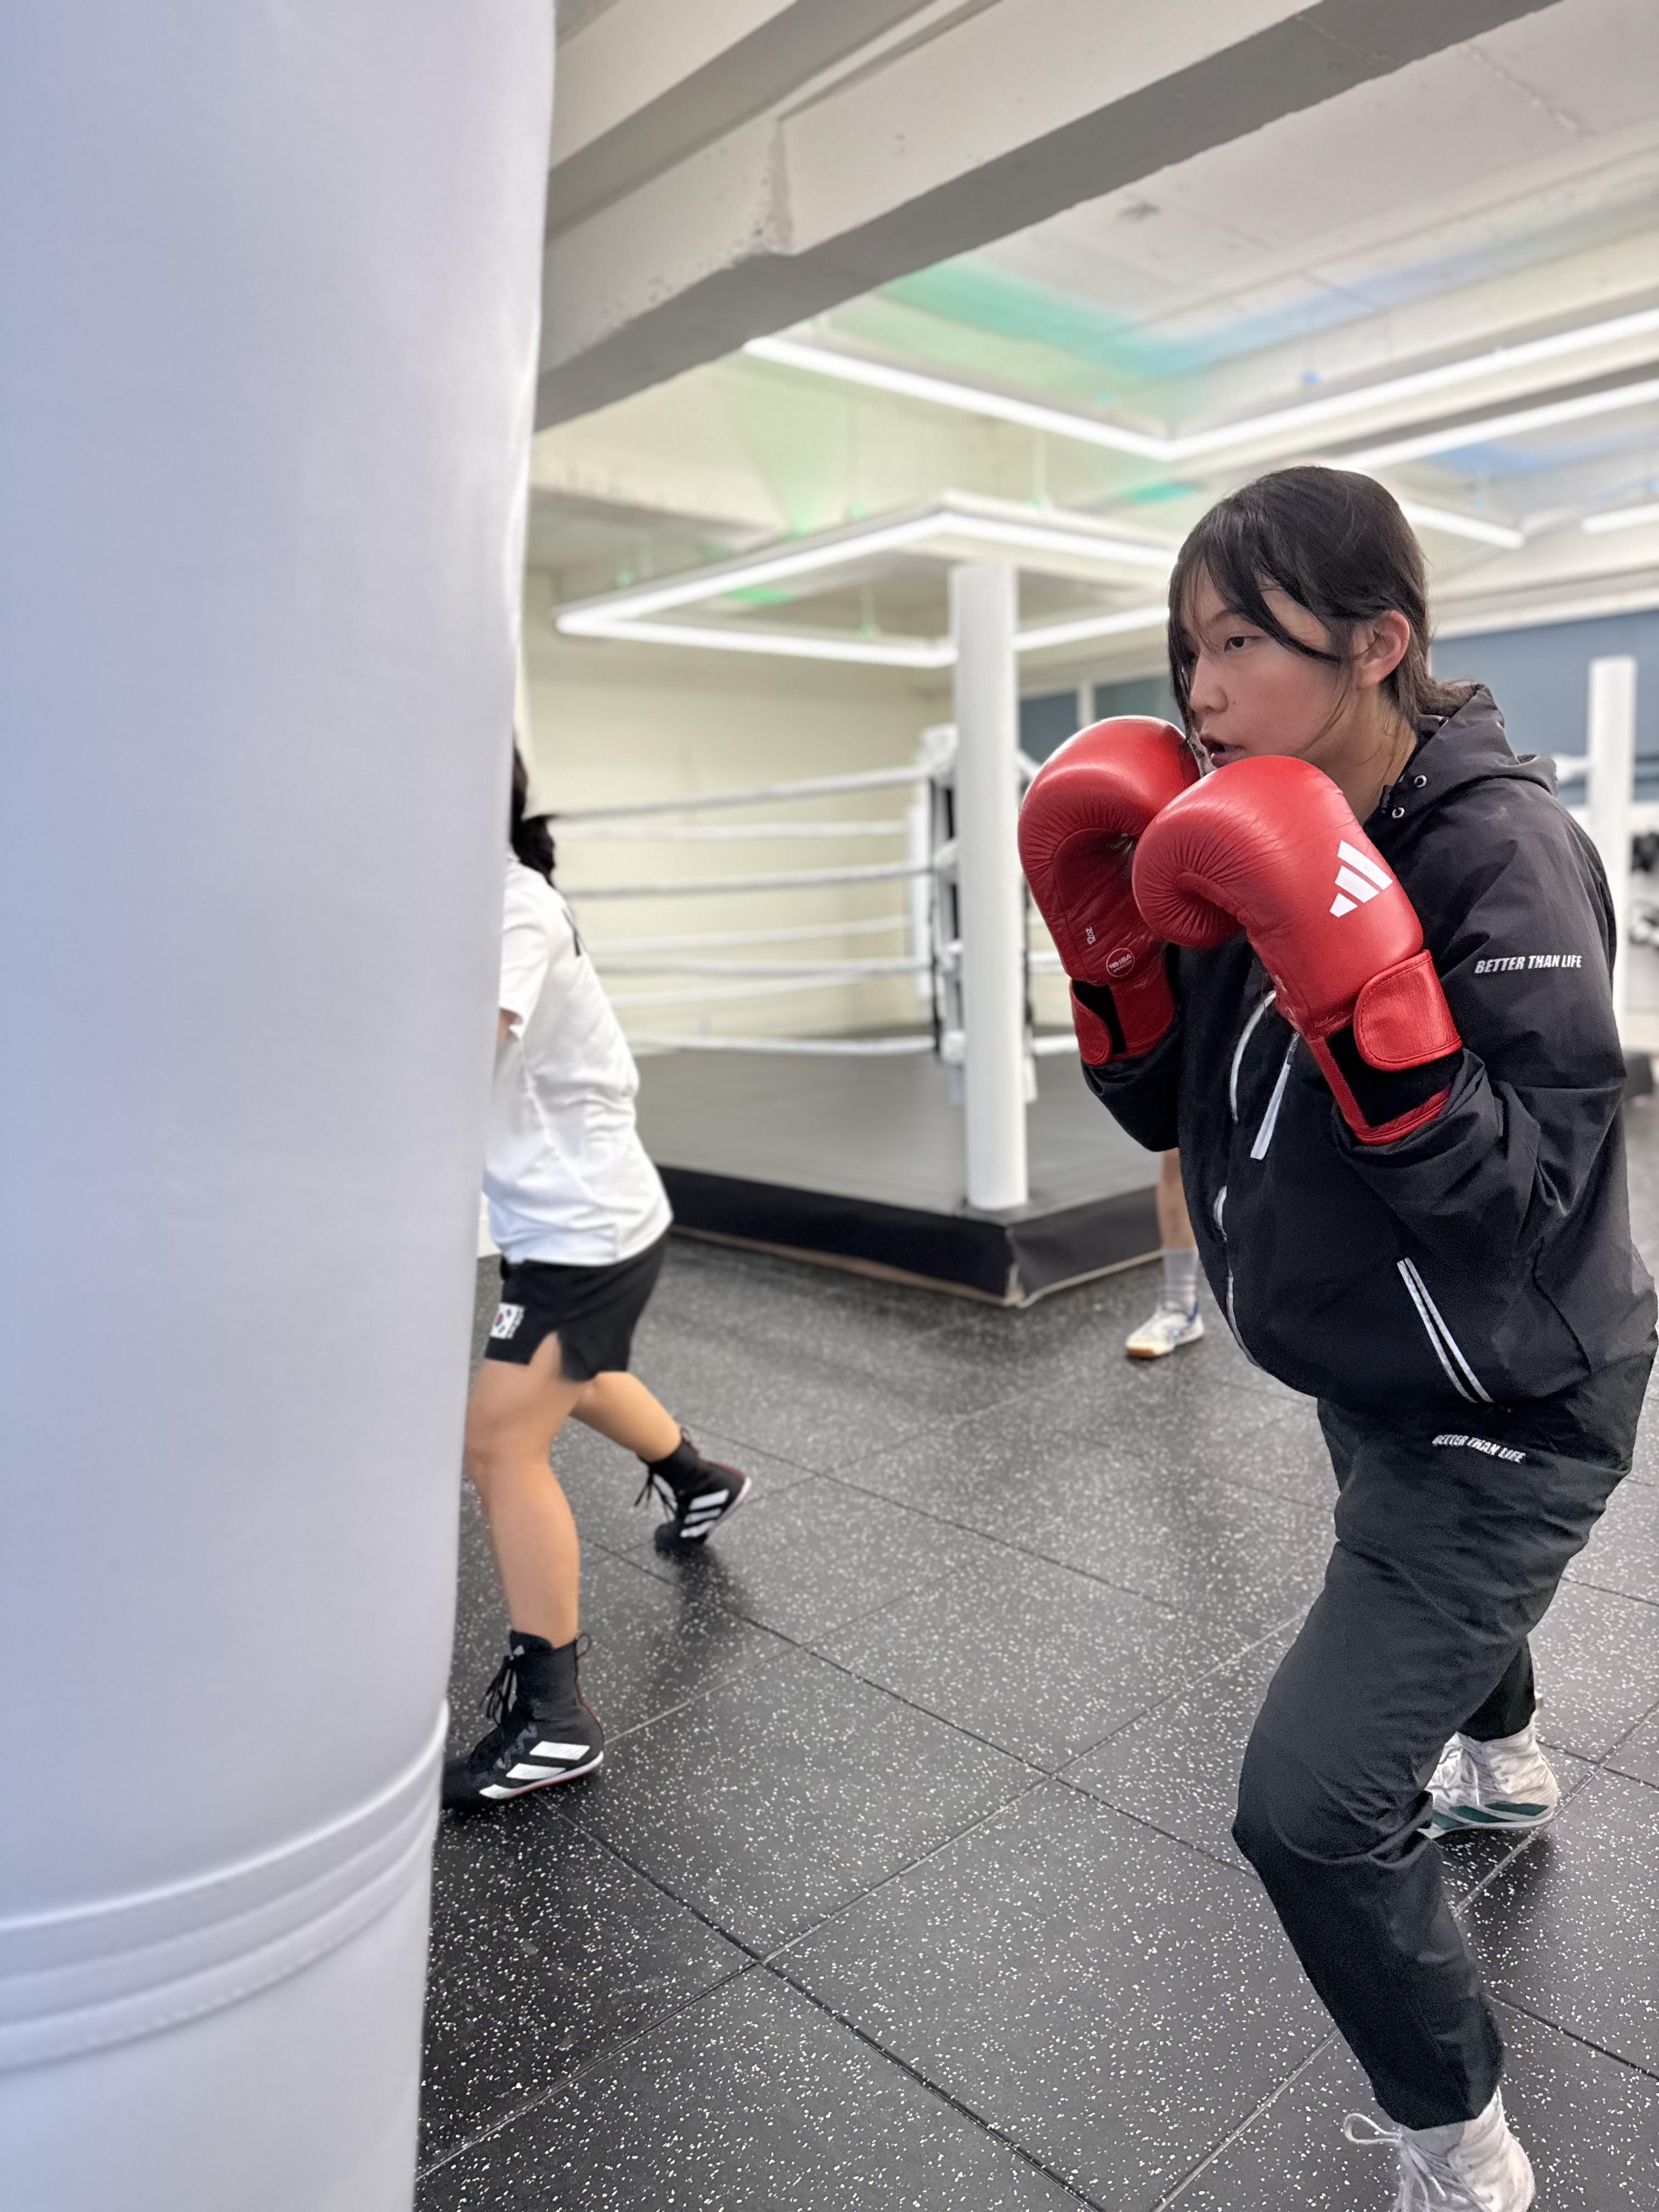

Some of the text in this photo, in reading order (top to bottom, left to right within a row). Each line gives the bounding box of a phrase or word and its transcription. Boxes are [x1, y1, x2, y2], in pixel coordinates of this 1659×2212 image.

[1474, 955, 1582, 974] BETTER THAN LIFE
[1467, 1437, 1500, 1455] THAN
[1498, 1447, 1526, 1463] LIFE
